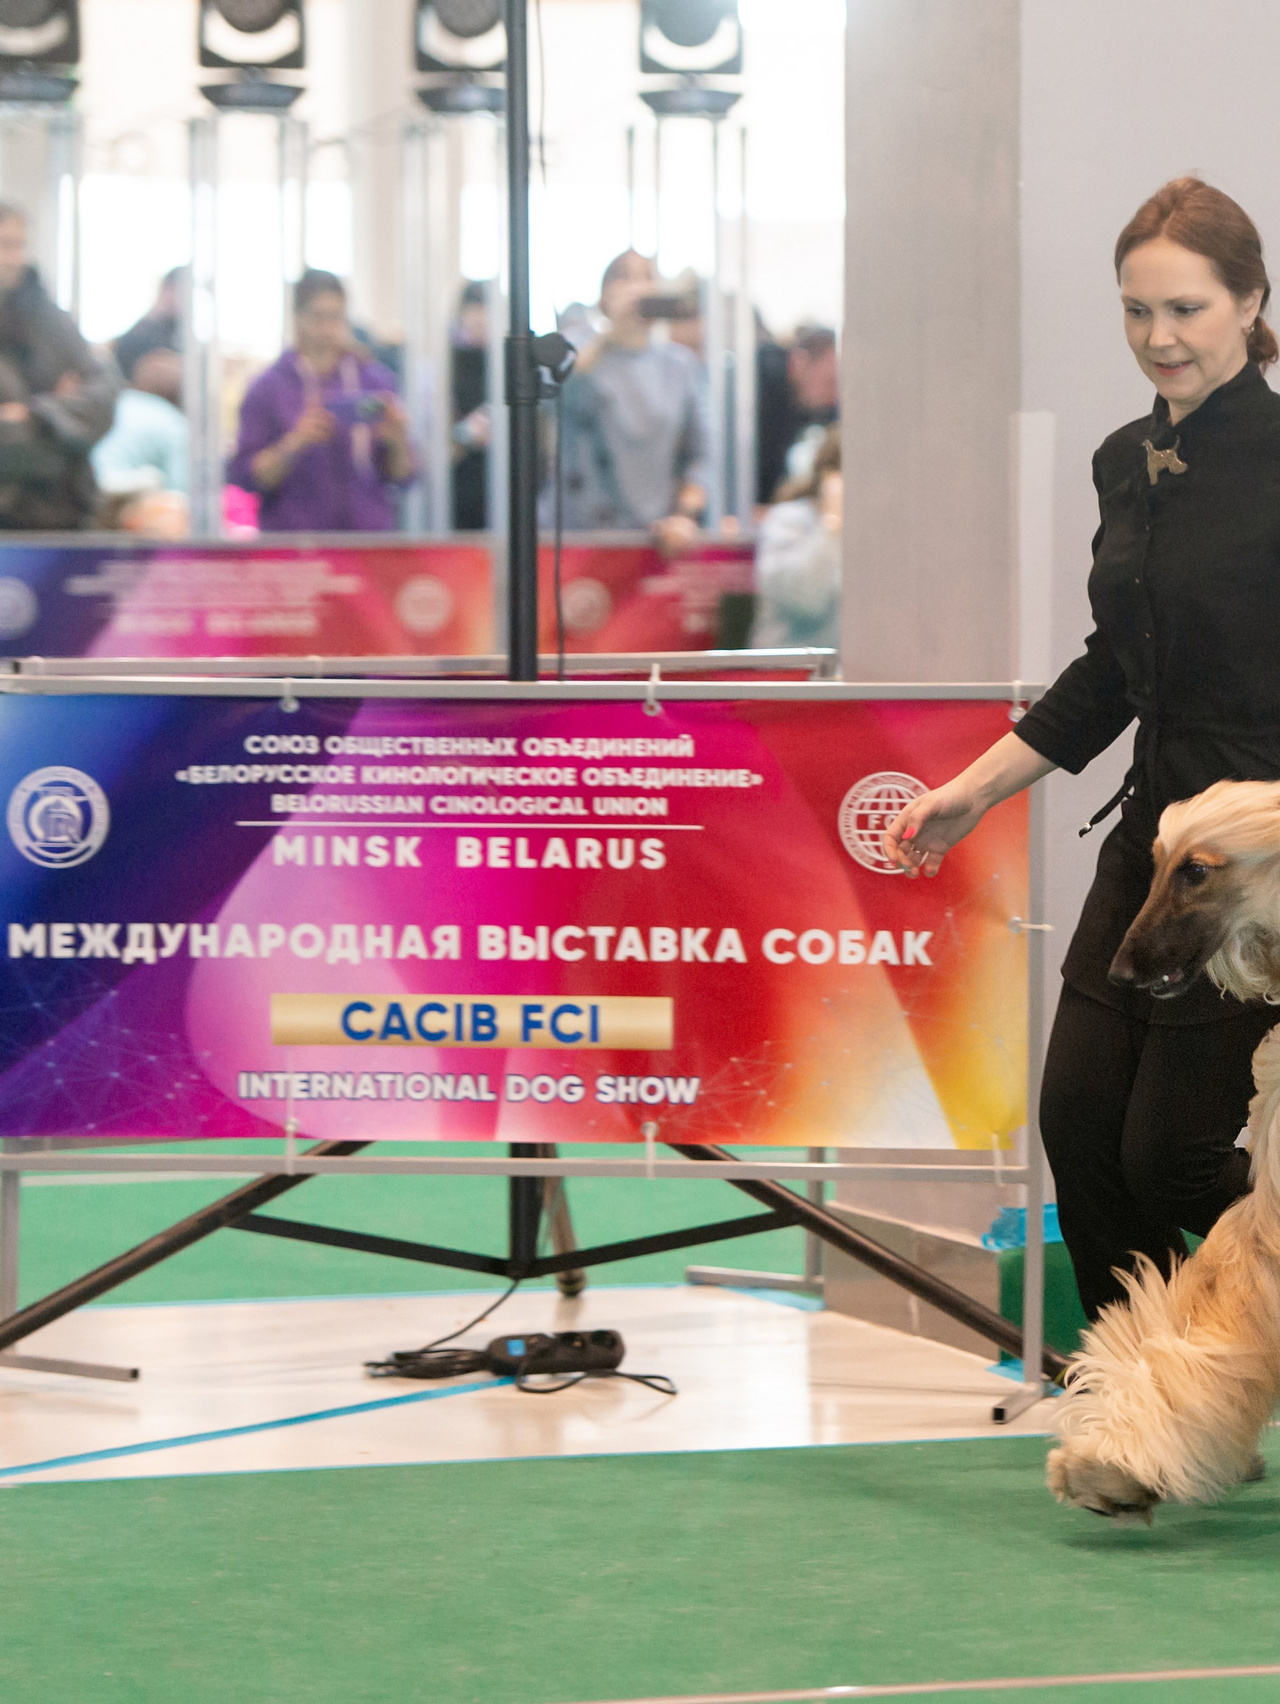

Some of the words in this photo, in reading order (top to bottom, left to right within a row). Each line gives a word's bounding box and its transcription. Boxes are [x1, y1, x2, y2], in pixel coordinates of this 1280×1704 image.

[243, 734, 320, 755] СОЮЗ
[323, 735, 518, 758] ОБЩЕСТВЕННЫХ
[521, 733, 695, 760] ОБЪЕДИНЕНИЙ
[175, 765, 356, 785] «БЕЛОРУССКОЕ
[360, 765, 578, 787] КИНОЛОГИЧЕСКОЕ
[581, 766, 764, 789] ОБЪЕДИНЕНИЕ»
[270, 793, 425, 814] BELORUSSIAN
[429, 795, 589, 816] CINOLOGICAL
[592, 796, 669, 816] UNION
[272, 835, 422, 867] MINSK
[455, 836, 667, 870] BELARUS
[8, 922, 461, 965] МЕЖДУНАРОДНАЯ
[477, 925, 748, 964] ВЫСТАВКА
[762, 928, 934, 966] СОБАК
[340, 1001, 499, 1042] CACIB
[521, 1003, 600, 1044] FCI
[238, 1070, 497, 1102] INTERNATIONAL
[506, 1073, 586, 1103] DOG
[595, 1075, 700, 1105] SHOW
